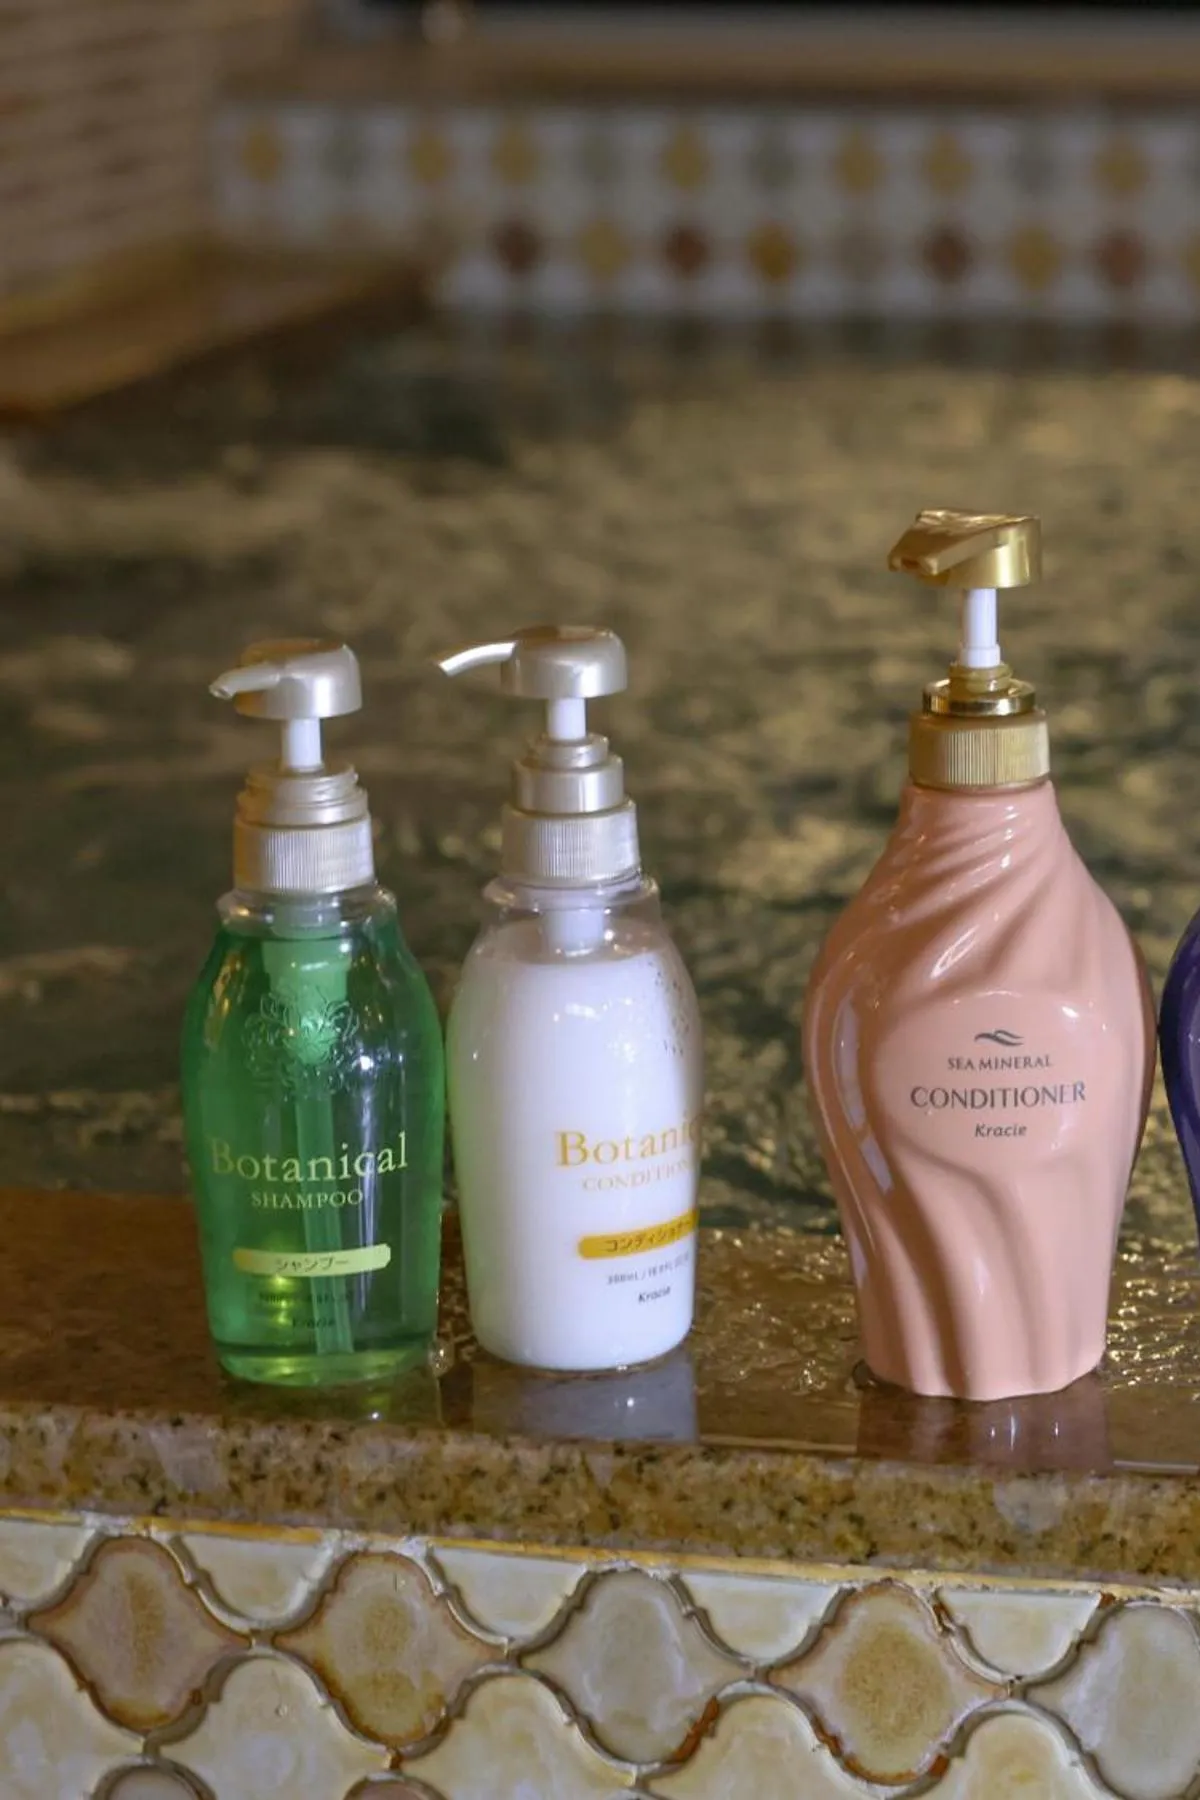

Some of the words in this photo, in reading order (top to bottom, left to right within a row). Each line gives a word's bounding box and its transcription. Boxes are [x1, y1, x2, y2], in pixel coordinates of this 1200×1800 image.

[947, 1056, 974, 1070] SEA
[979, 1054, 1052, 1071] MINERAL
[910, 1081, 1086, 1109] CONDITIONER
[974, 1123, 1027, 1138] Kracie
[210, 1130, 408, 1183] Botanical
[251, 1189, 363, 1208] SHAMPOO
